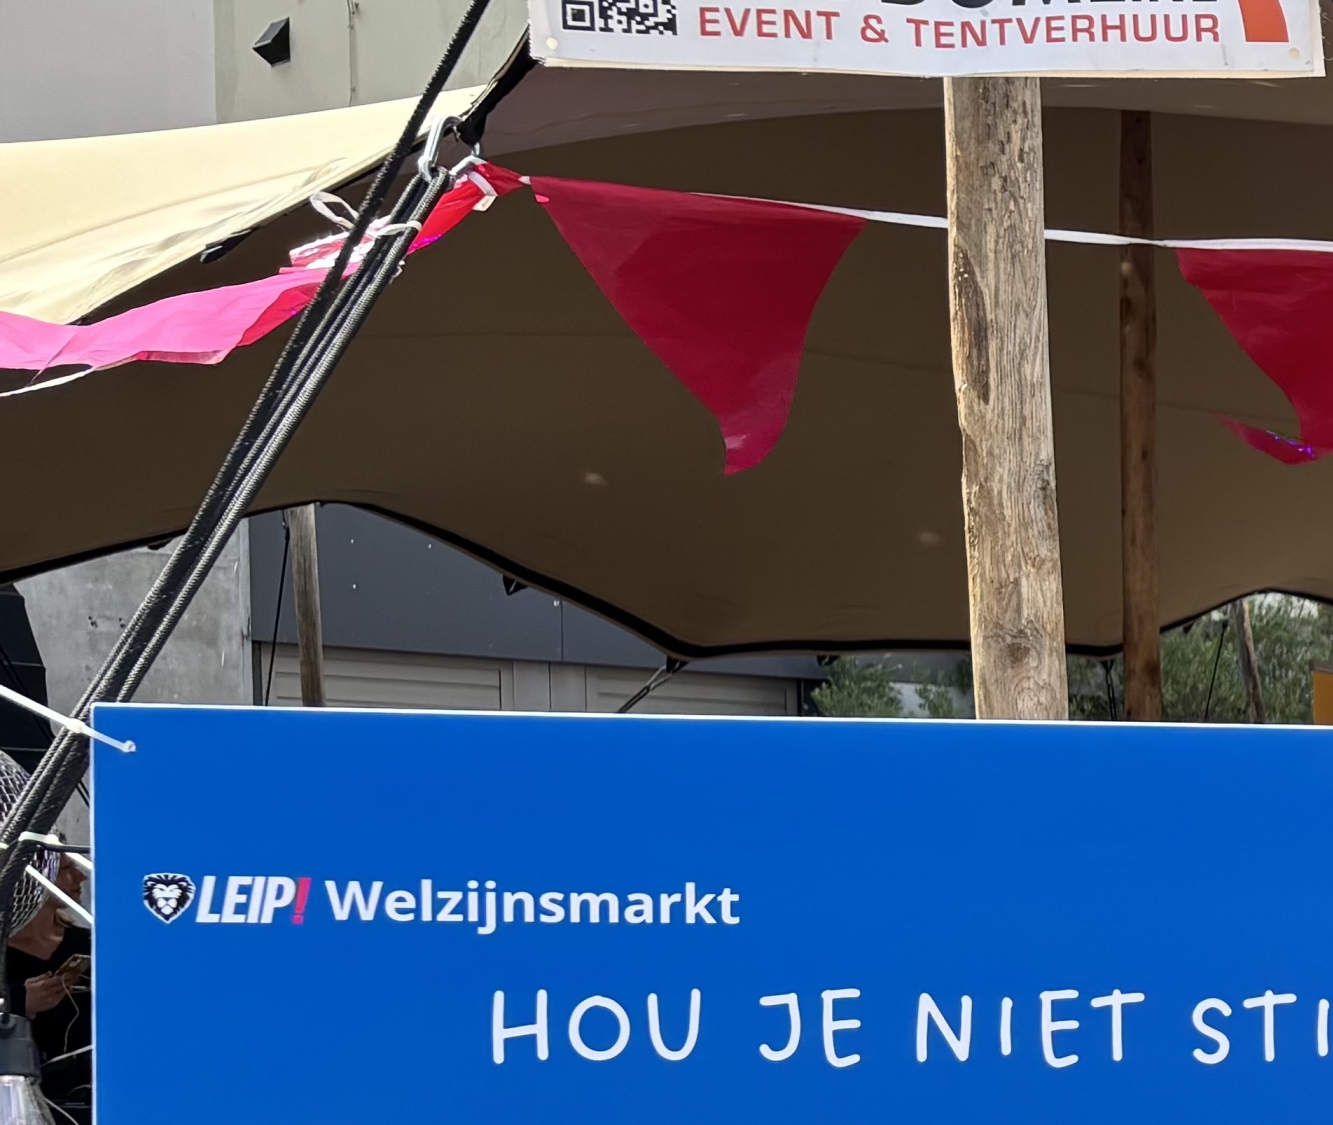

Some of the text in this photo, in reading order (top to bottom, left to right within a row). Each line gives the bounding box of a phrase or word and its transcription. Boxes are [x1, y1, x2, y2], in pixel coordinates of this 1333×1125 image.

[698, 6, 1220, 49] EVENT & TENTVERHUUR
[195, 875, 741, 935] LEIP! Welzijnsmarkt
[491, 987, 702, 1065] HOU
[758, 987, 863, 1068] JE
[916, 988, 1145, 1068] NIET
